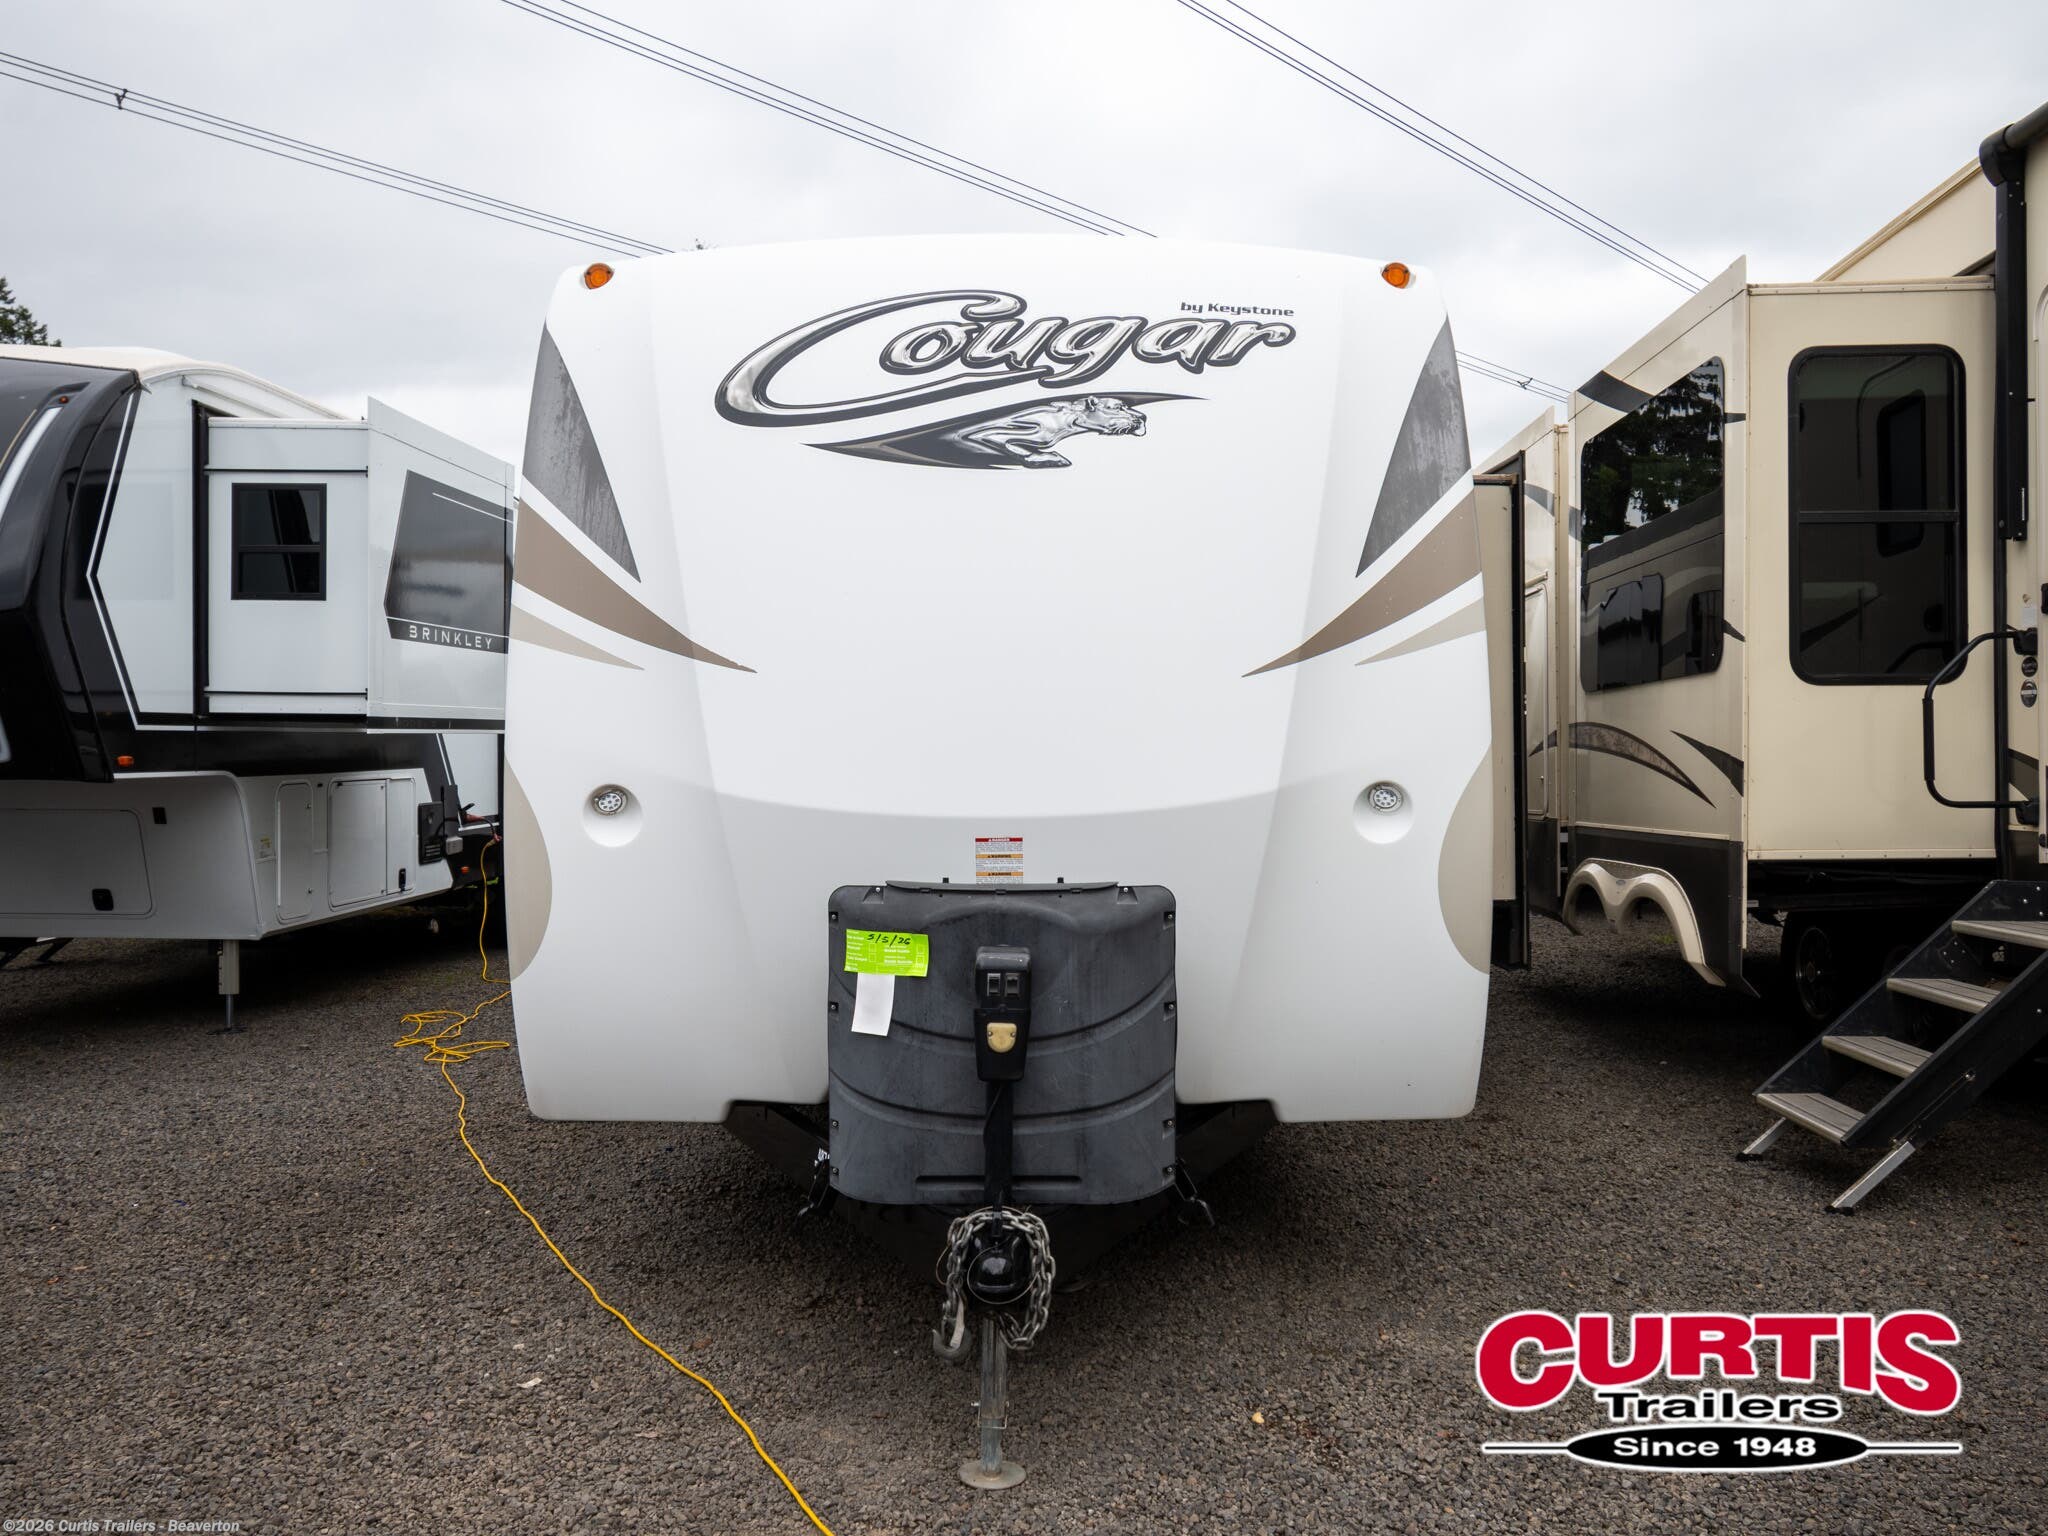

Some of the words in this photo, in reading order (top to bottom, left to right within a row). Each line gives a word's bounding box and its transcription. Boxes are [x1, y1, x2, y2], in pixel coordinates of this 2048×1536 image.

[1180, 302, 1203, 313] by
[1208, 303, 1295, 316] Keystone
[713, 290, 1296, 427] Cougar
[409, 625, 493, 649] BRINKLEY
